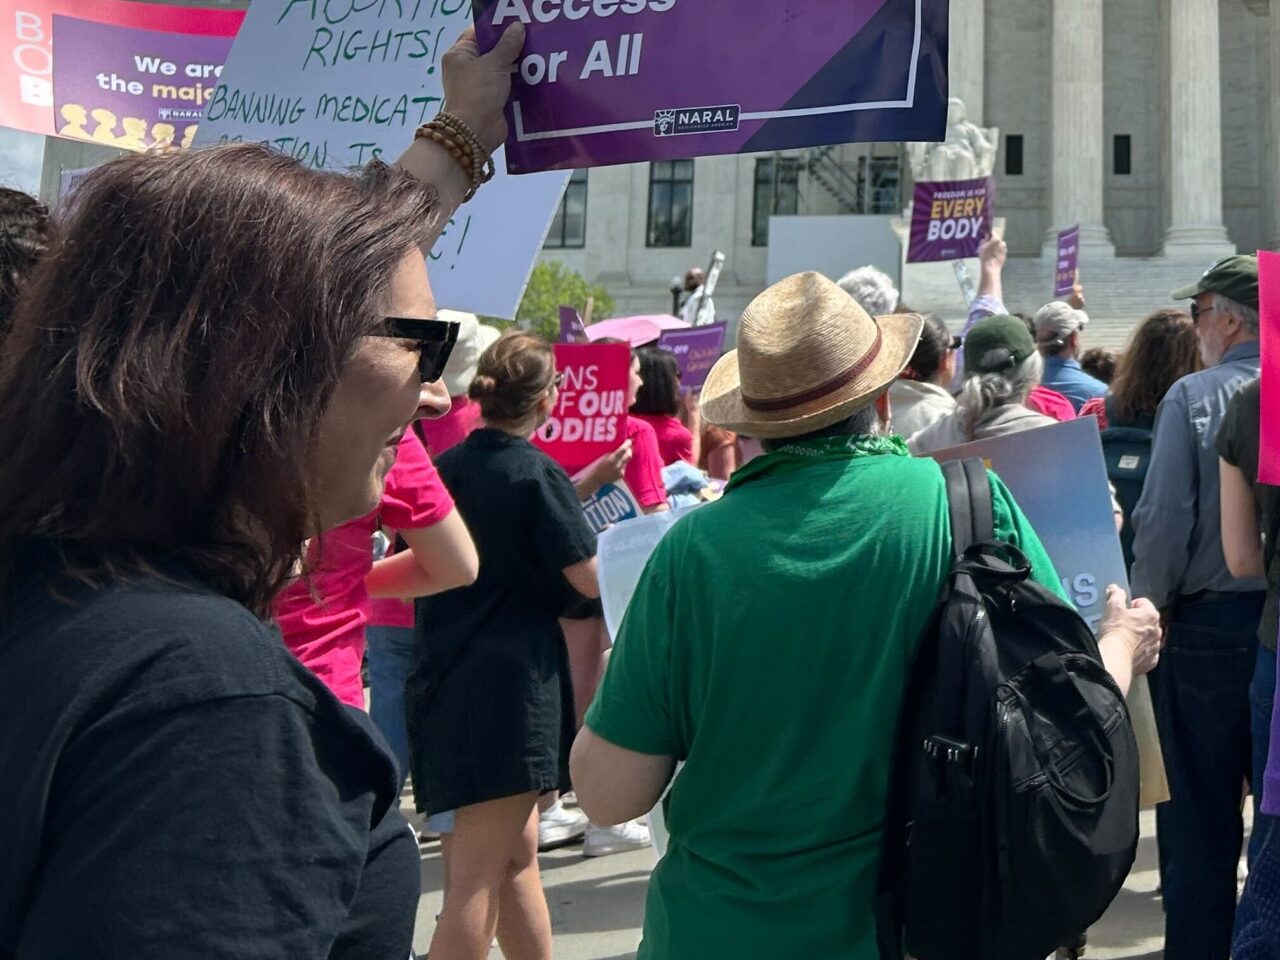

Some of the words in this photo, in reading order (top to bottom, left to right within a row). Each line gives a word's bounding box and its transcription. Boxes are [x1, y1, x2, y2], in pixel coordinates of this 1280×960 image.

[303, 26, 446, 76] RIGHTS!
[512, 50, 568, 87] or
[579, 33, 643, 80] All
[134, 56, 177, 76] We
[96, 73, 144, 95] the
[207, 84, 306, 125] BANNING
[678, 109, 734, 125] NARAL
[930, 197, 984, 218] EVERY
[927, 217, 983, 241] BODY
[560, 365, 599, 390] NS
[578, 389, 624, 416] OUR
[1063, 572, 1099, 608] S
